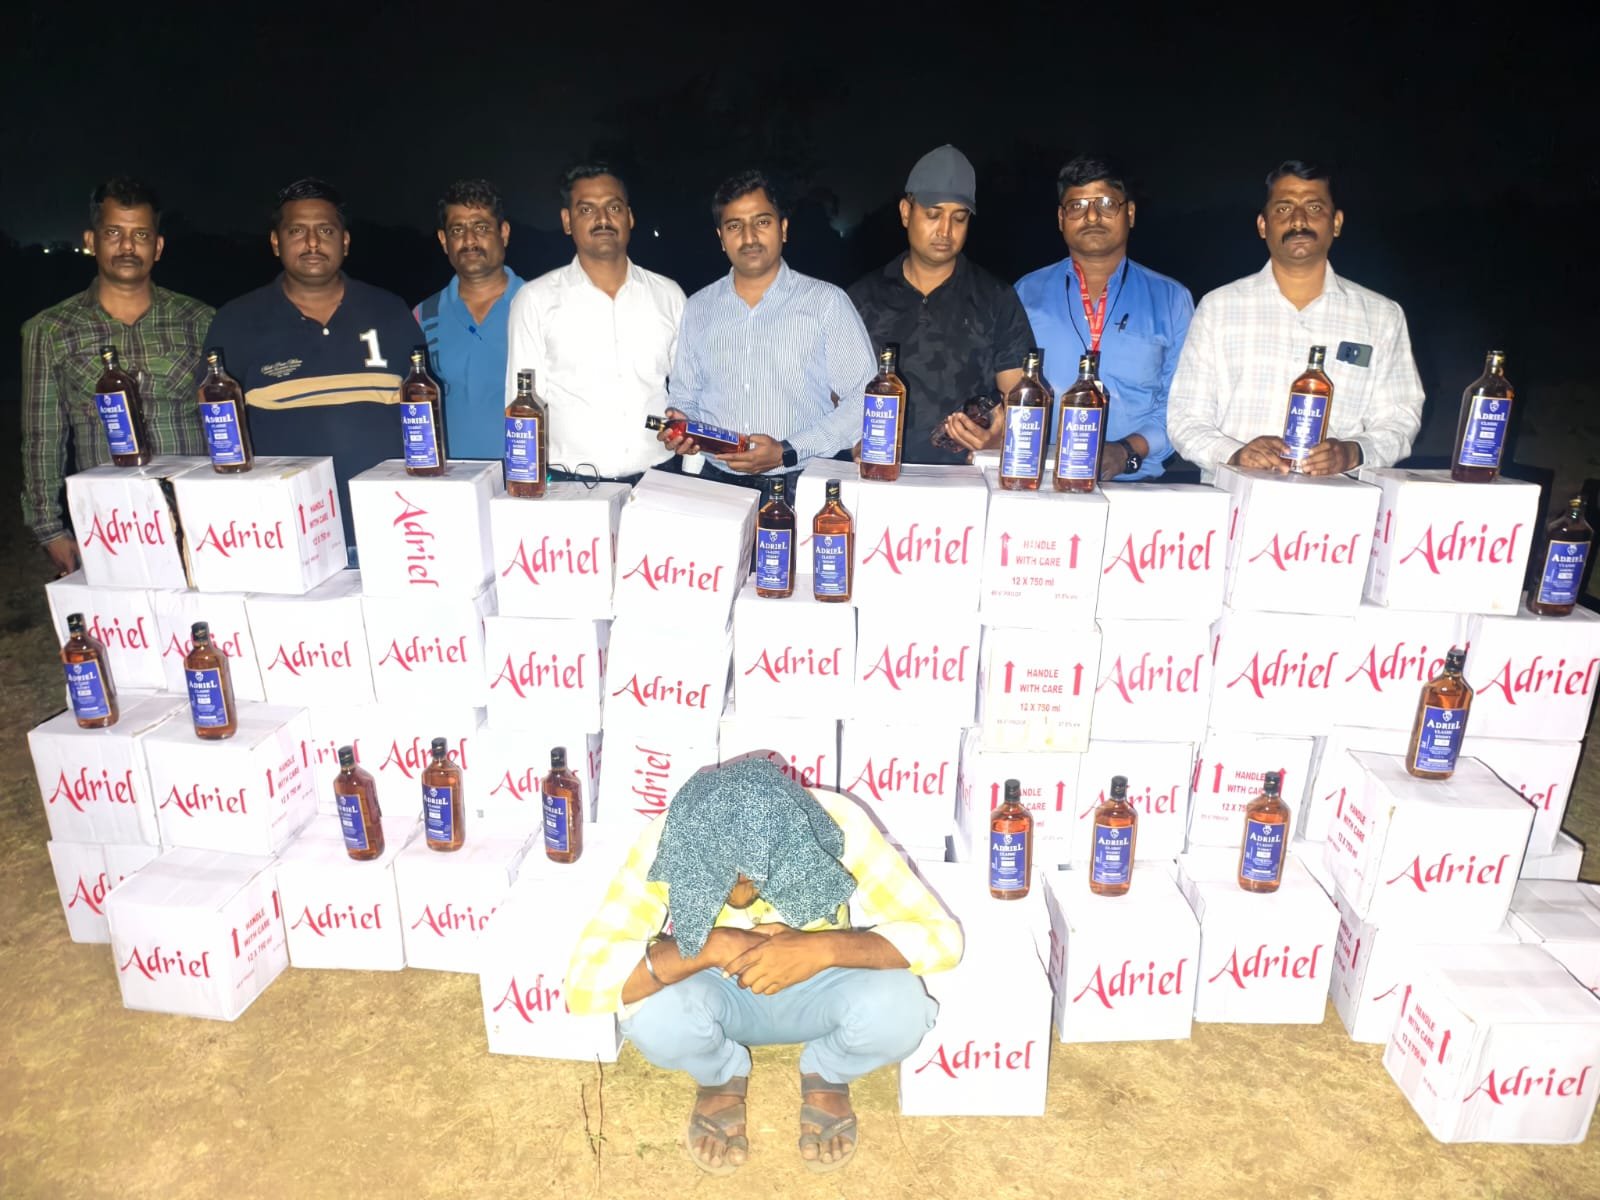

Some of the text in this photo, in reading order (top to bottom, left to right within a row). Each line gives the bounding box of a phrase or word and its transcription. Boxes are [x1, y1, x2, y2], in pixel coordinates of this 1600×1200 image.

[360, 329, 388, 368] 1
[866, 408, 895, 418] ADRIEL
[1066, 421, 1098, 431] ADRIEL
[506, 429, 534, 439] ADRIEL
[84, 509, 165, 555] Adriel
[196, 521, 284, 558] Adriel
[393, 491, 439, 588] Adriel
[760, 541, 788, 550] ADRIEL
[816, 546, 844, 555] ADRIEL
[863, 523, 973, 575] Adriel
[1400, 521, 1523, 575] Adriel
[502, 536, 600, 585] Adriel
[1104, 530, 1216, 583] Adriel
[1249, 531, 1360, 571] Adriel
[622, 555, 722, 592] Adriel
[87, 616, 149, 649] driel
[268, 641, 352, 676] Adriel
[379, 636, 468, 671] Adriel
[745, 647, 840, 683] Adriel
[863, 643, 970, 691] Adriel
[490, 652, 584, 698] Adriel
[613, 674, 710, 709] Adriel
[1020, 684, 1063, 693] WITH CARE
[1027, 669, 1059, 678] HANDLE
[1095, 652, 1203, 704] Adriel
[1227, 649, 1338, 699] Adriel
[1476, 656, 1600, 705] Adriel
[1427, 719, 1462, 729] ADRIEL
[50, 767, 136, 813] Adriel
[846, 757, 949, 801] Adriel
[1227, 784, 1246, 794] WITH
[160, 784, 247, 816] Adriel
[992, 843, 1024, 851] ADRIEL
[1098, 836, 1129, 845] ADRIEL
[1250, 832, 1281, 842] ADRIEL
[1386, 854, 1510, 892] Adriel
[291, 904, 382, 937] Adriel
[121, 946, 210, 981] Adriel
[1209, 944, 1323, 989] Adriel
[1073, 959, 1187, 1009] Adriel
[915, 1040, 1035, 1078] Adriel
[1463, 1066, 1592, 1105] Adriel
